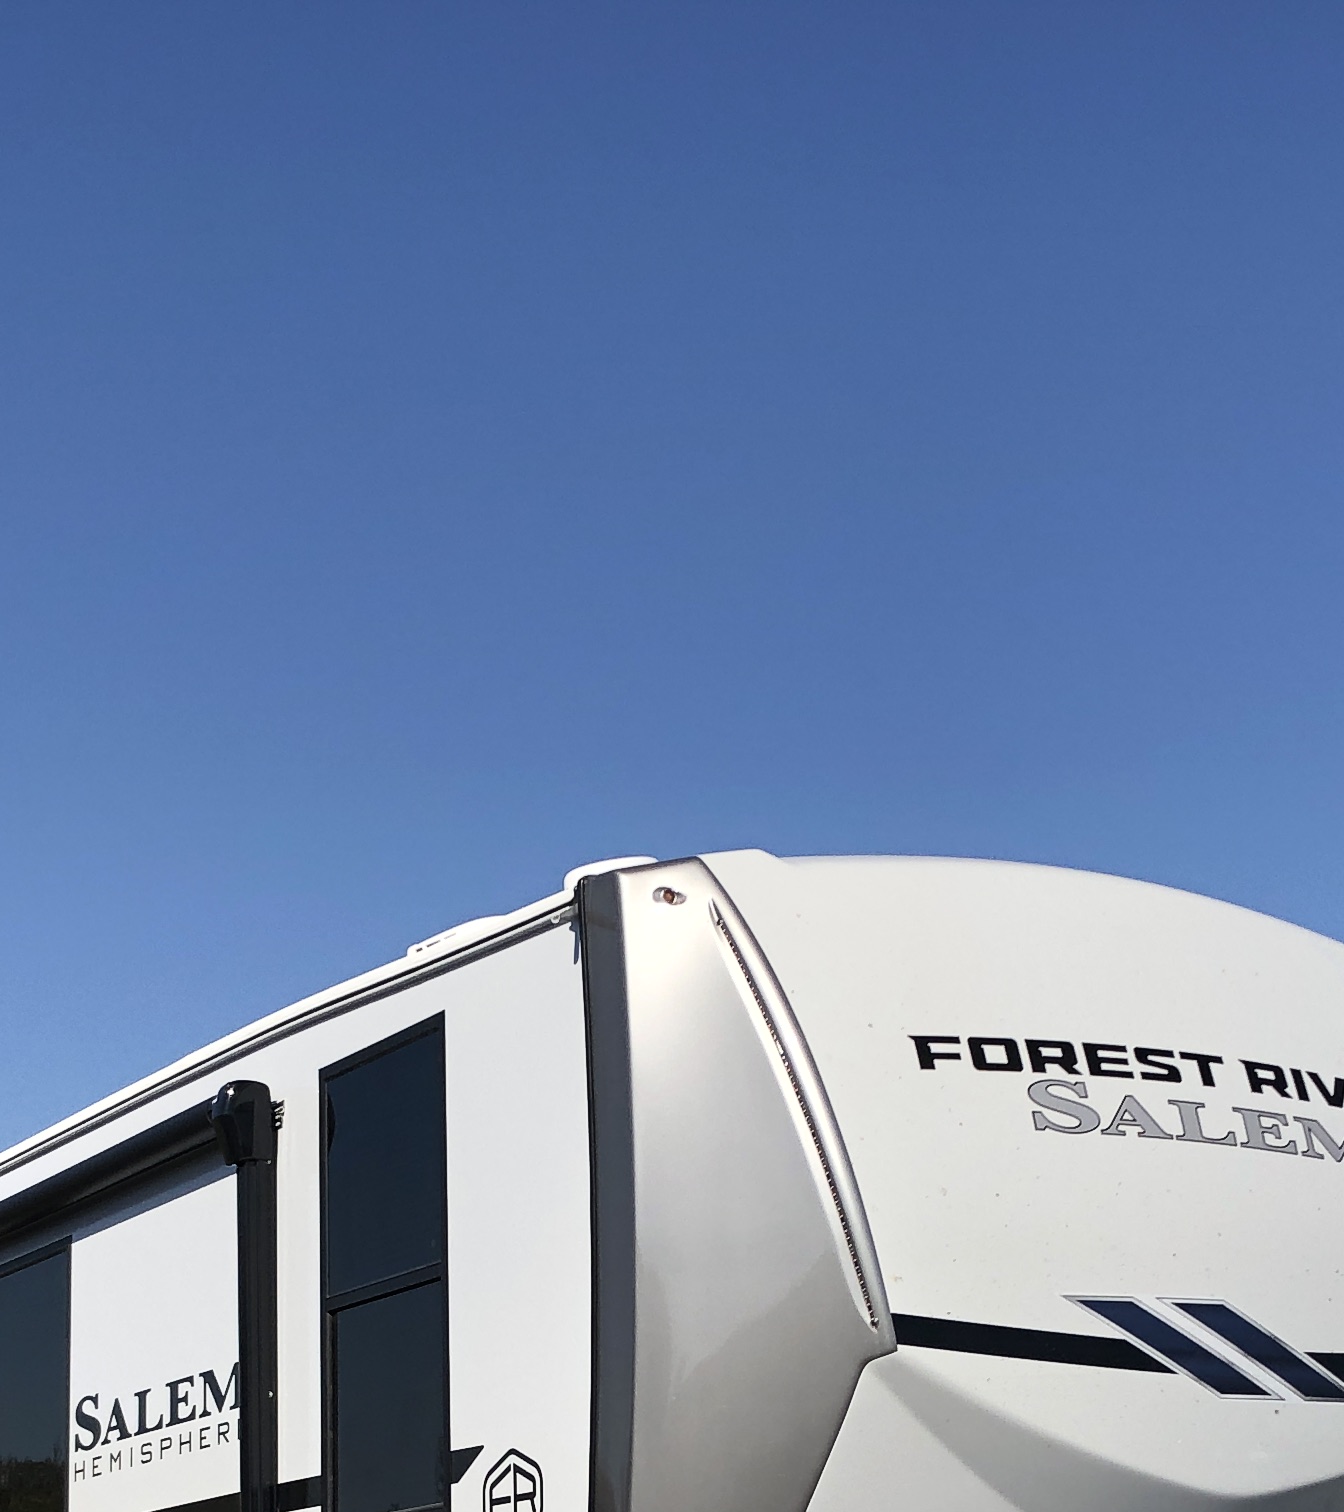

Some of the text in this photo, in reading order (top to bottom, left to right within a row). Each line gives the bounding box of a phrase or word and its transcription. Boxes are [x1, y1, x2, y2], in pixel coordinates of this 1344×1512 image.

[907, 1035, 1224, 1088] FOREST
[74, 1361, 241, 1453] SALEM
[74, 1418, 241, 1482] HEMISPHER
